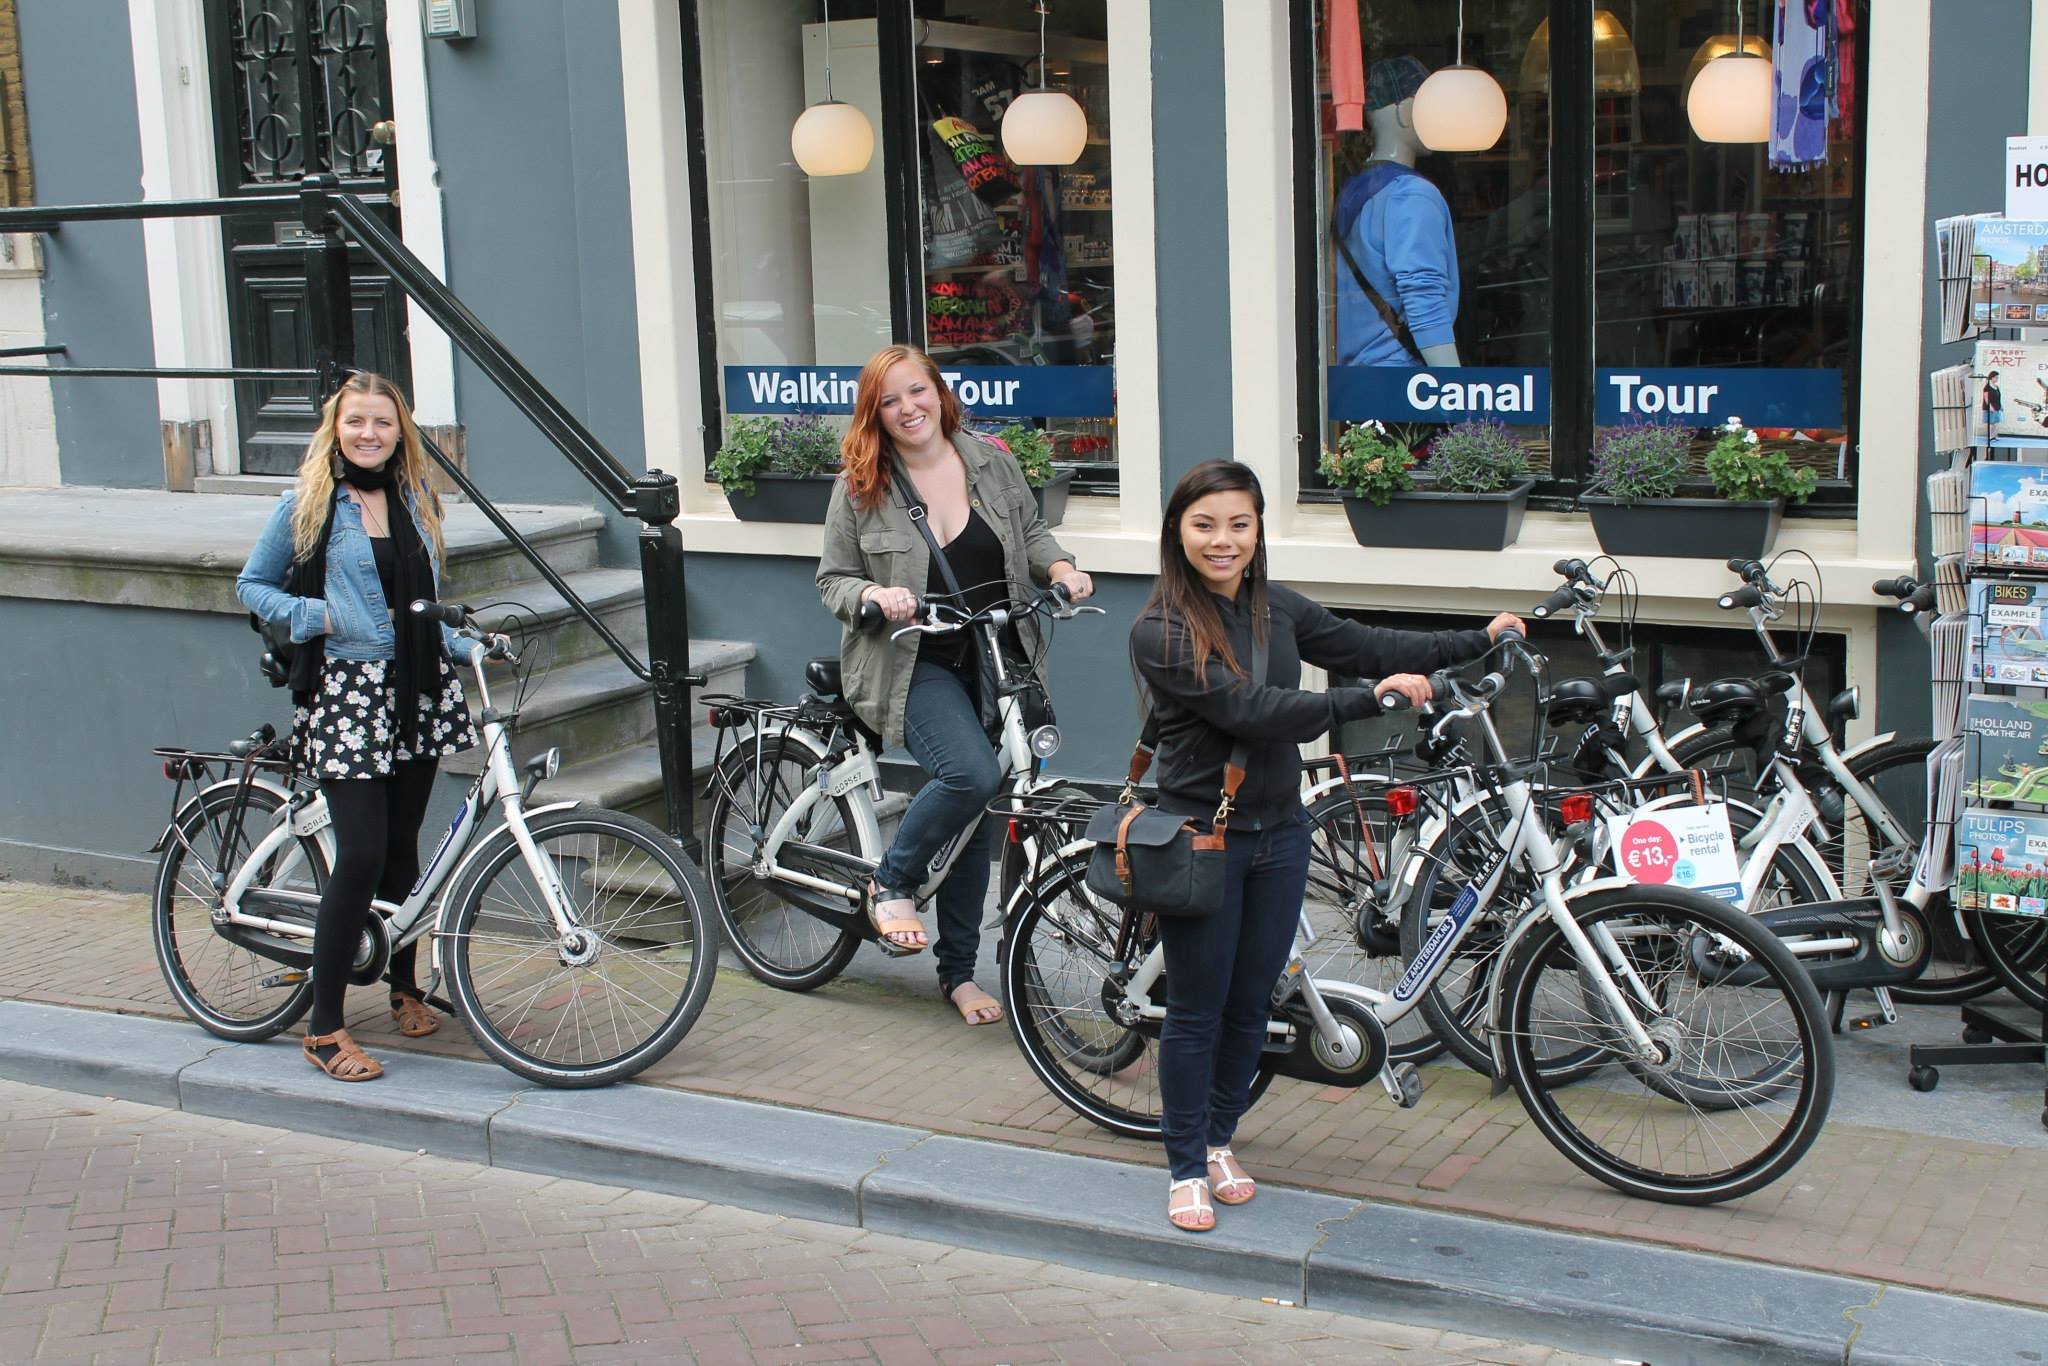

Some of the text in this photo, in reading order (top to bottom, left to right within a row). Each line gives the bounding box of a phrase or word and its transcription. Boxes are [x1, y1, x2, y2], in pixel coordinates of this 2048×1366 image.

[1982, 223, 2048, 236] AMSTERD
[1988, 356, 2027, 368] ART
[747, 371, 1020, 406] Walkin Tour
[1406, 372, 1719, 414] Canal Tour
[1994, 585, 2028, 600] BIKES
[1991, 609, 2037, 619] EXAMPLE
[1974, 718, 2033, 731] HOLLAND
[2000, 729, 2016, 738] THE
[2017, 731, 2031, 739] AIR
[1967, 817, 2025, 834] TULIPS
[1632, 835, 1663, 846] One day:
[1687, 831, 1725, 844] Bicycle
[1969, 831, 2007, 842] PHOTOS
[1690, 844, 1720, 856] rental
[1400, 973, 1413, 991] SEE
[1411, 921, 1452, 977] AMSTERDAM.NL
